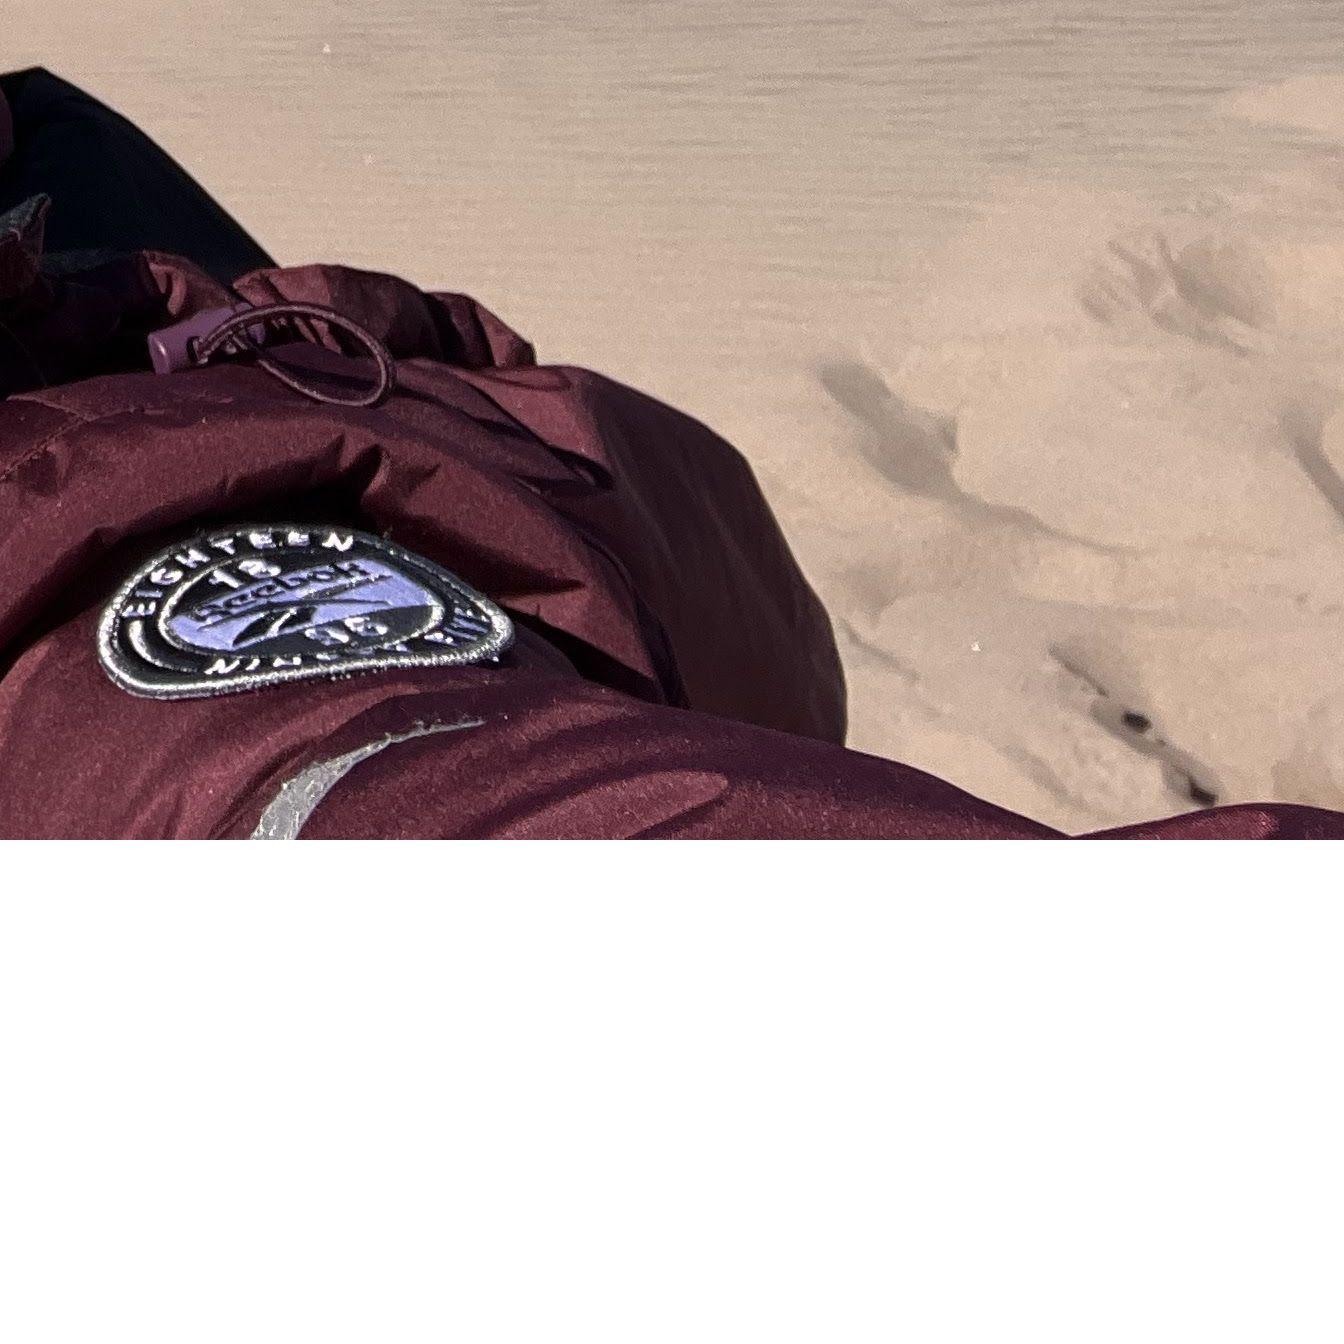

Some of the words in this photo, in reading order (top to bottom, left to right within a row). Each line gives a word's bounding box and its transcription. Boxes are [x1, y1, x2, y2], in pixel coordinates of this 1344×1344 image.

[121, 530, 354, 618] EIGHTEEN
[192, 561, 372, 623] Reebok
[208, 558, 281, 589] 18
